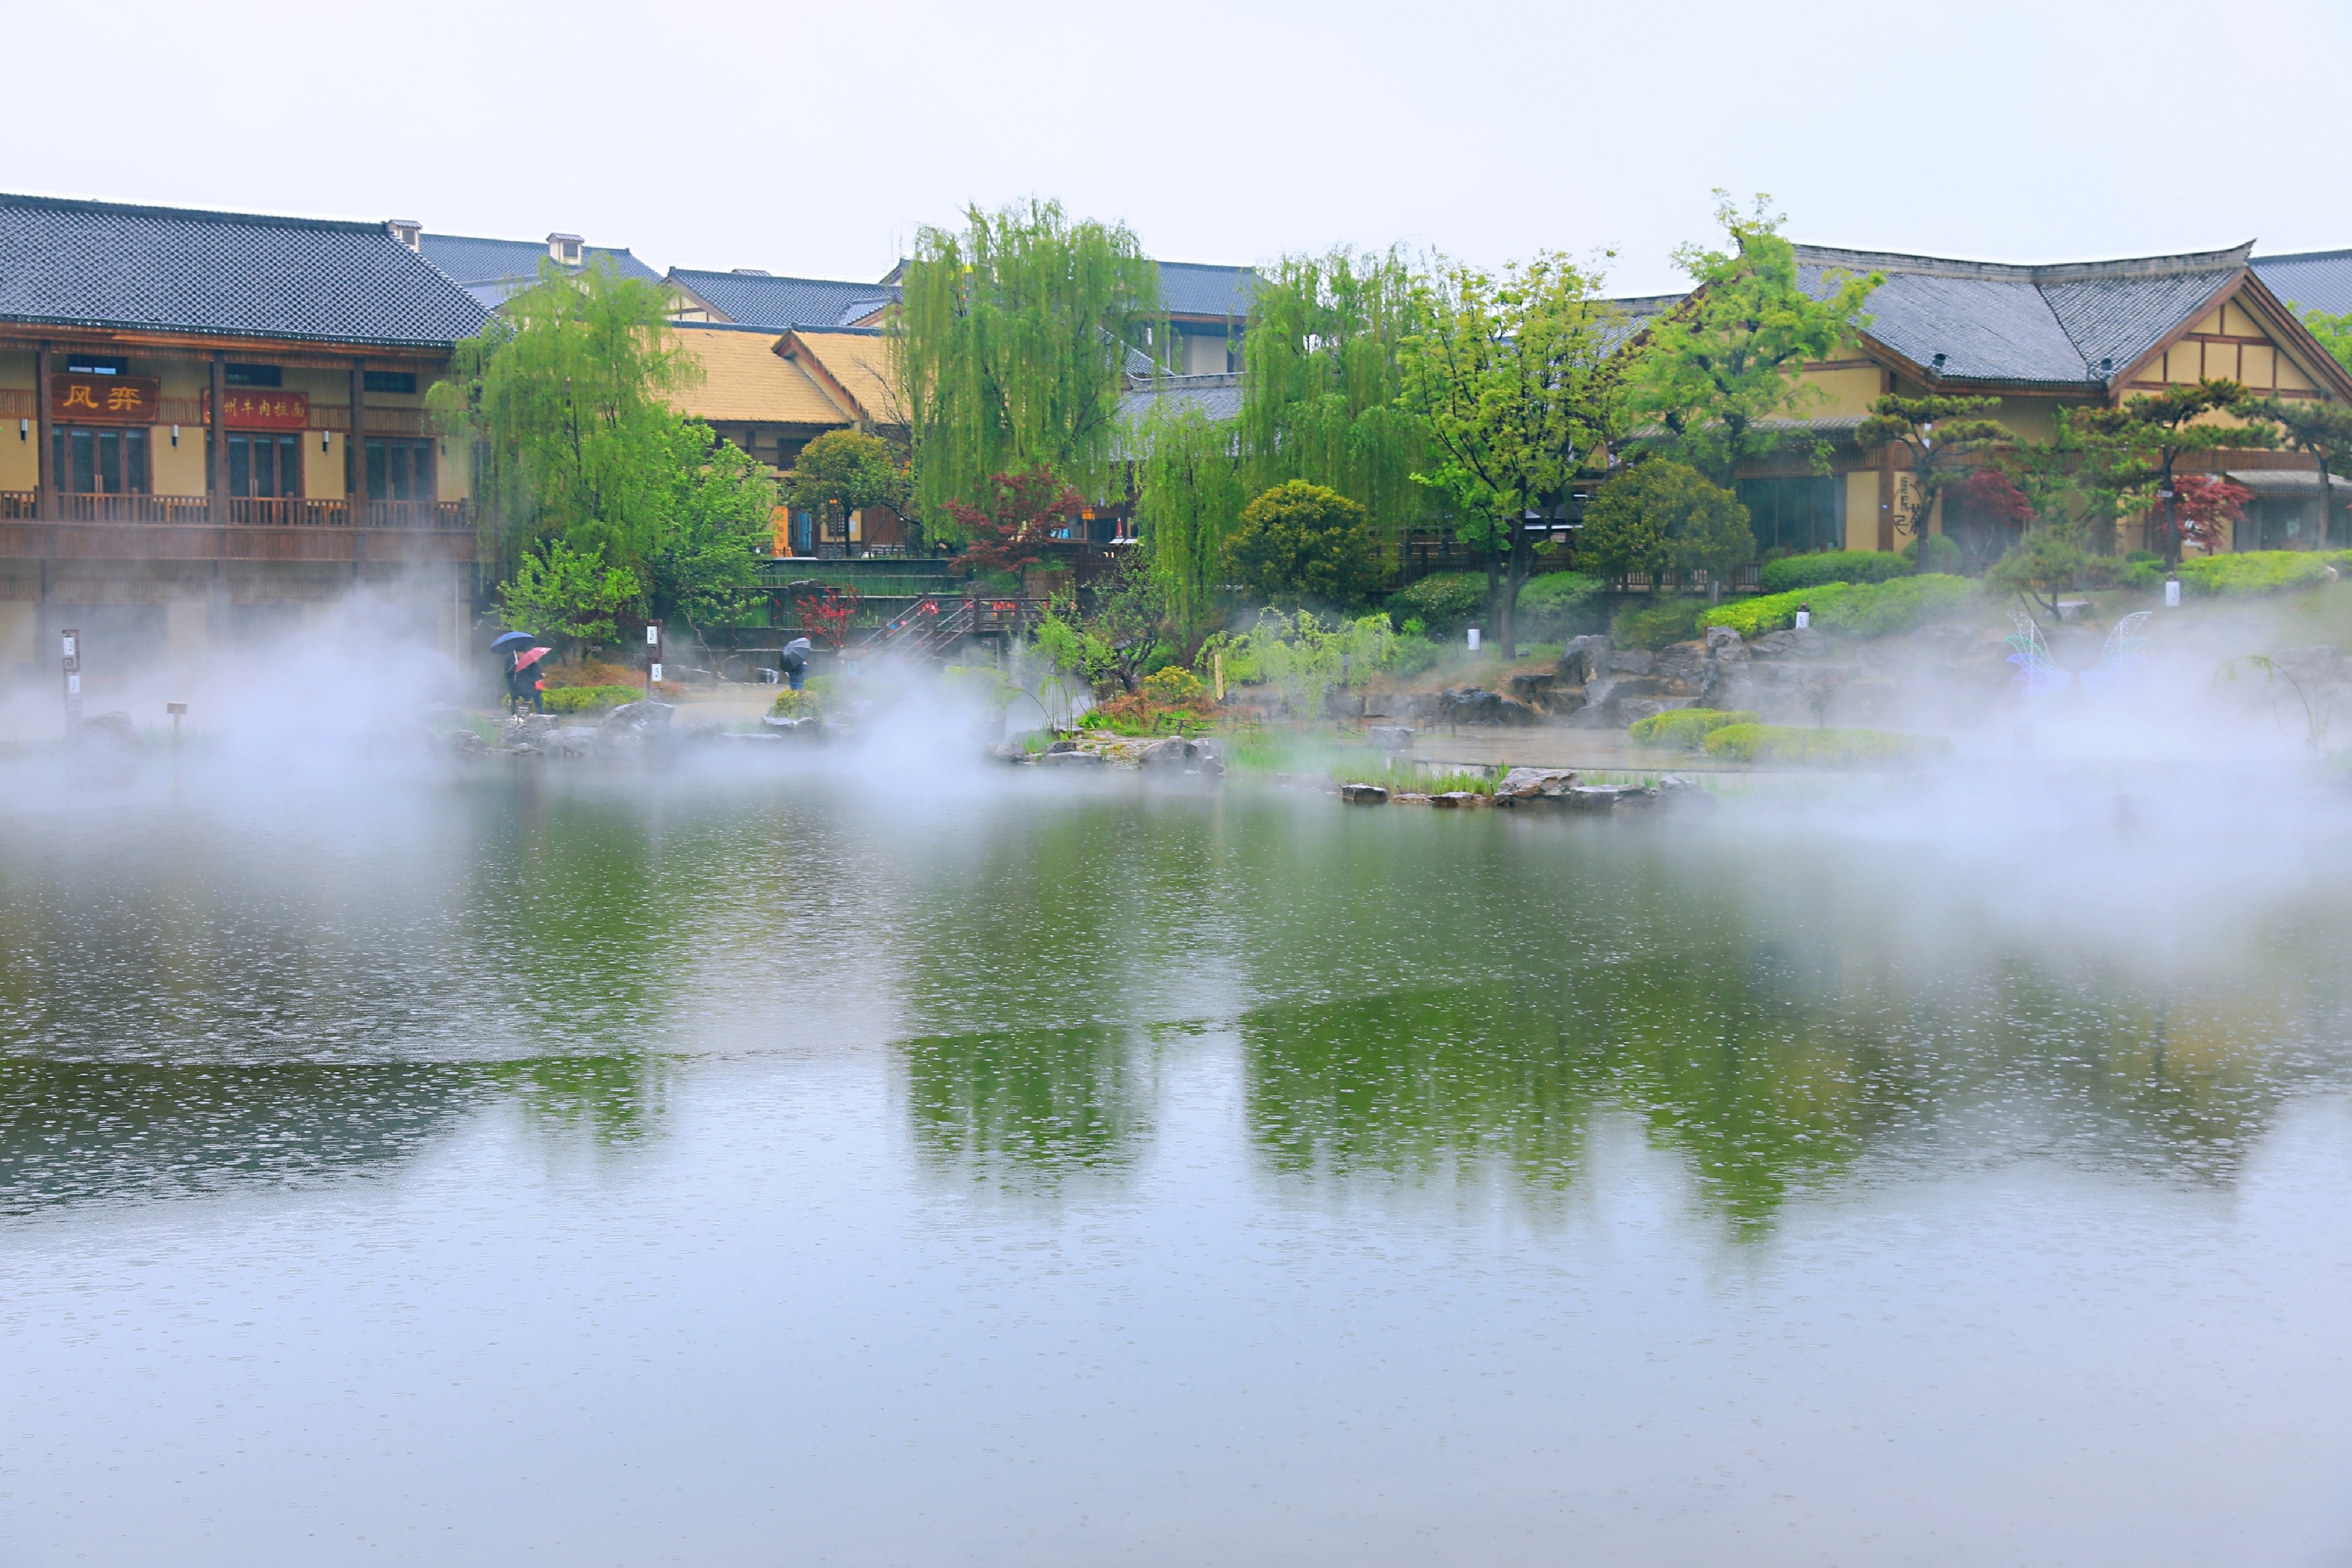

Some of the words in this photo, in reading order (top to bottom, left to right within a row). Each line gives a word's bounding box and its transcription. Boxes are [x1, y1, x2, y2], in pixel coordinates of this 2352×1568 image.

[207, 397, 305, 418] 州牛肉拉面
